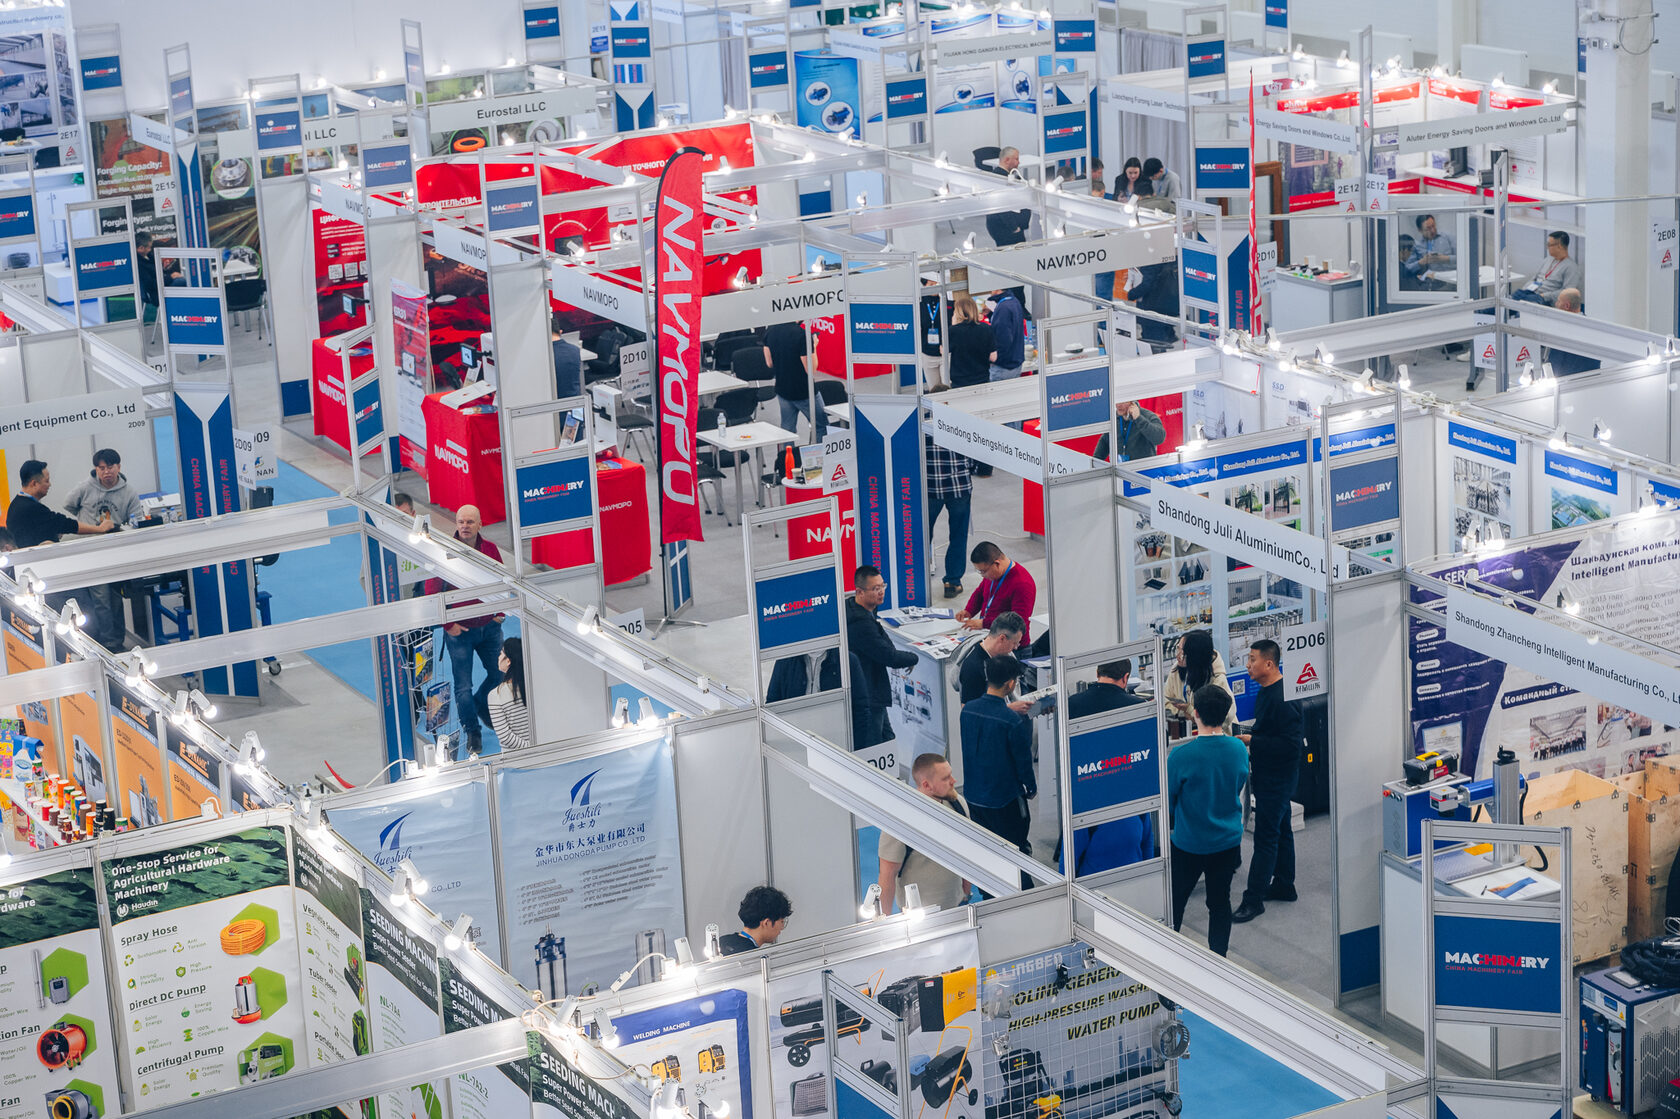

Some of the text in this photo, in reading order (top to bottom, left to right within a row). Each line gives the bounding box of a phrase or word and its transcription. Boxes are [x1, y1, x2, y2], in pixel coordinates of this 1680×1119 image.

[478, 101, 546, 118] Eurostal LLC
[60, 131, 78, 140] 2E17
[315, 128, 337, 140] LLC
[1475, 123, 1495, 133] Doors
[1496, 121, 1508, 131] and
[1508, 118, 1537, 130] Windows
[97, 161, 163, 176] Forging Capacity:
[633, 159, 666, 171] ТОЧНОГО
[155, 182, 176, 192] 2E15
[1338, 184, 1360, 195] 2E12
[1366, 179, 1386, 191] 2E12
[102, 215, 153, 228] Forgin type:
[1657, 230, 1676, 242] 2E08
[460, 242, 487, 259] NAVMOP
[1036, 248, 1107, 271] NAVMOPO
[583, 286, 619, 310] NAVMOPO
[171, 315, 218, 324] MACHINERY
[855, 322, 909, 331] MACHINERY
[623, 350, 648, 365] 2D10
[663, 194, 696, 506] NAVMOPO
[1051, 388, 1103, 405] MACHINERY
[24, 413, 88, 432] Equipment
[90, 409, 114, 421] Co.,
[117, 403, 136, 415] Ltd
[128, 421, 146, 430] 2D09
[254, 431, 271, 444] 09
[825, 439, 852, 455] 2D08
[937, 419, 1013, 456] Shandong Shengshida
[434, 443, 470, 474] NAVMOPO
[481, 447, 503, 455] NAVMO
[191, 458, 202, 490] CHINA
[256, 468, 275, 477] NAN
[524, 480, 583, 498] MACHINERY
[869, 476, 880, 507] CHINA
[1335, 481, 1391, 502] MACHINERY
[599, 501, 632, 512] NAVMOPO
[901, 477, 915, 600] CHINA MACHINERY FAIR
[1158, 500, 1211, 534] Shandong
[1213, 522, 1233, 545] Juli
[1320, 560, 1339, 579] Ld
[1571, 562, 1625, 581] Intelligent
[763, 595, 830, 617] MACHINERY
[1286, 635, 1326, 653] 2D06
[1455, 612, 1672, 702] Shandong Zhancheng Intelligent Manufacturing Co.,
[1504, 685, 1559, 705] Командный
[1077, 749, 1150, 776] MACHINERY
[535, 822, 646, 858] 金华市东大泵业有限公司
[112, 846, 220, 876] One-Stop Service for
[536, 855, 563, 868] JINHUA
[563, 849, 596, 863] DONGDA
[597, 844, 618, 856] PUMP
[113, 856, 231, 892] Agricultural Hardware
[9, 888, 25, 899] for
[114, 881, 170, 902] Machinery
[121, 924, 177, 948] Spray Hose
[369, 909, 404, 948] SEEDING
[1444, 951, 1549, 969] MACHINERY
[129, 984, 206, 1011] Direct DC Pump
[450, 979, 487, 1017] SEEDING
[1008, 995, 1106, 1032] HIGH-PRESSURE
[1067, 1003, 1160, 1040] WATER PUMP
[22, 1024, 41, 1035] Fan
[633, 1022, 691, 1042] WELDING MACHINE
[137, 1045, 224, 1076] Centrifugal Pump
[541, 1053, 586, 1098] SEEDING
[543, 1075, 563, 1094] Super
[563, 1084, 584, 1107] Power
[1, 1097, 20, 1106] Fan
[543, 1090, 574, 1114] Better Seed
